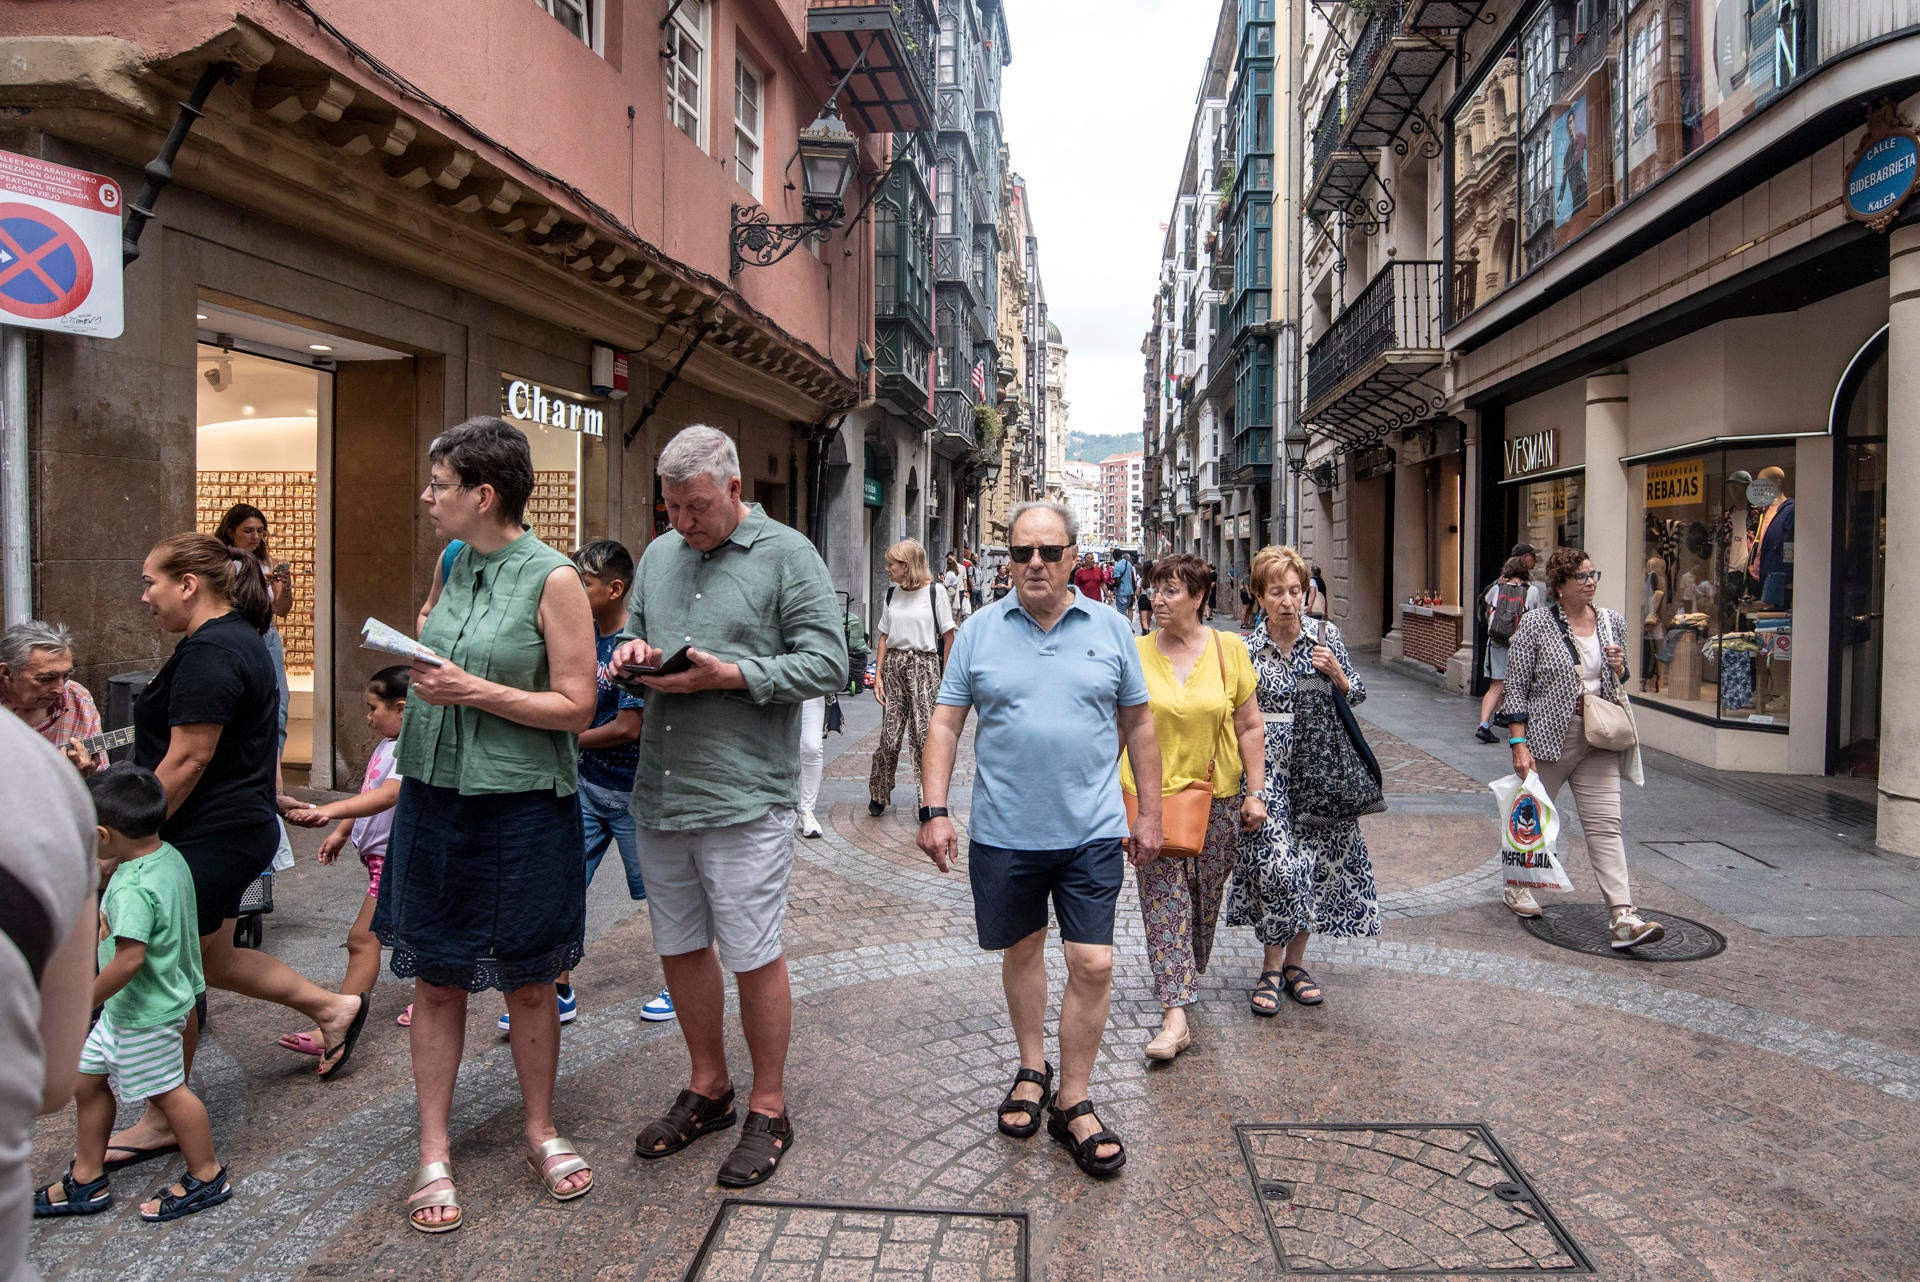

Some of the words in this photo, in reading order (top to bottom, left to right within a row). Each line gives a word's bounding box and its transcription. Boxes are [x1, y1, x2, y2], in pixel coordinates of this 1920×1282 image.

[1866, 138, 1897, 161] CALLE
[44, 166, 97, 184] ARAUTUTAKO
[44, 173, 72, 185] GUNEA
[1850, 152, 1916, 196] BIDEBARRIETA
[6, 182, 35, 195] CASCO
[38, 190, 61, 200] VIEJO
[46, 185, 90, 201] REGULADA
[104, 189, 115, 202] B
[1867, 191, 1897, 212] KALEA
[508, 380, 604, 437] Charm
[1504, 429, 1553, 475] VESMAN
[1647, 476, 1699, 500] REBAJAS
